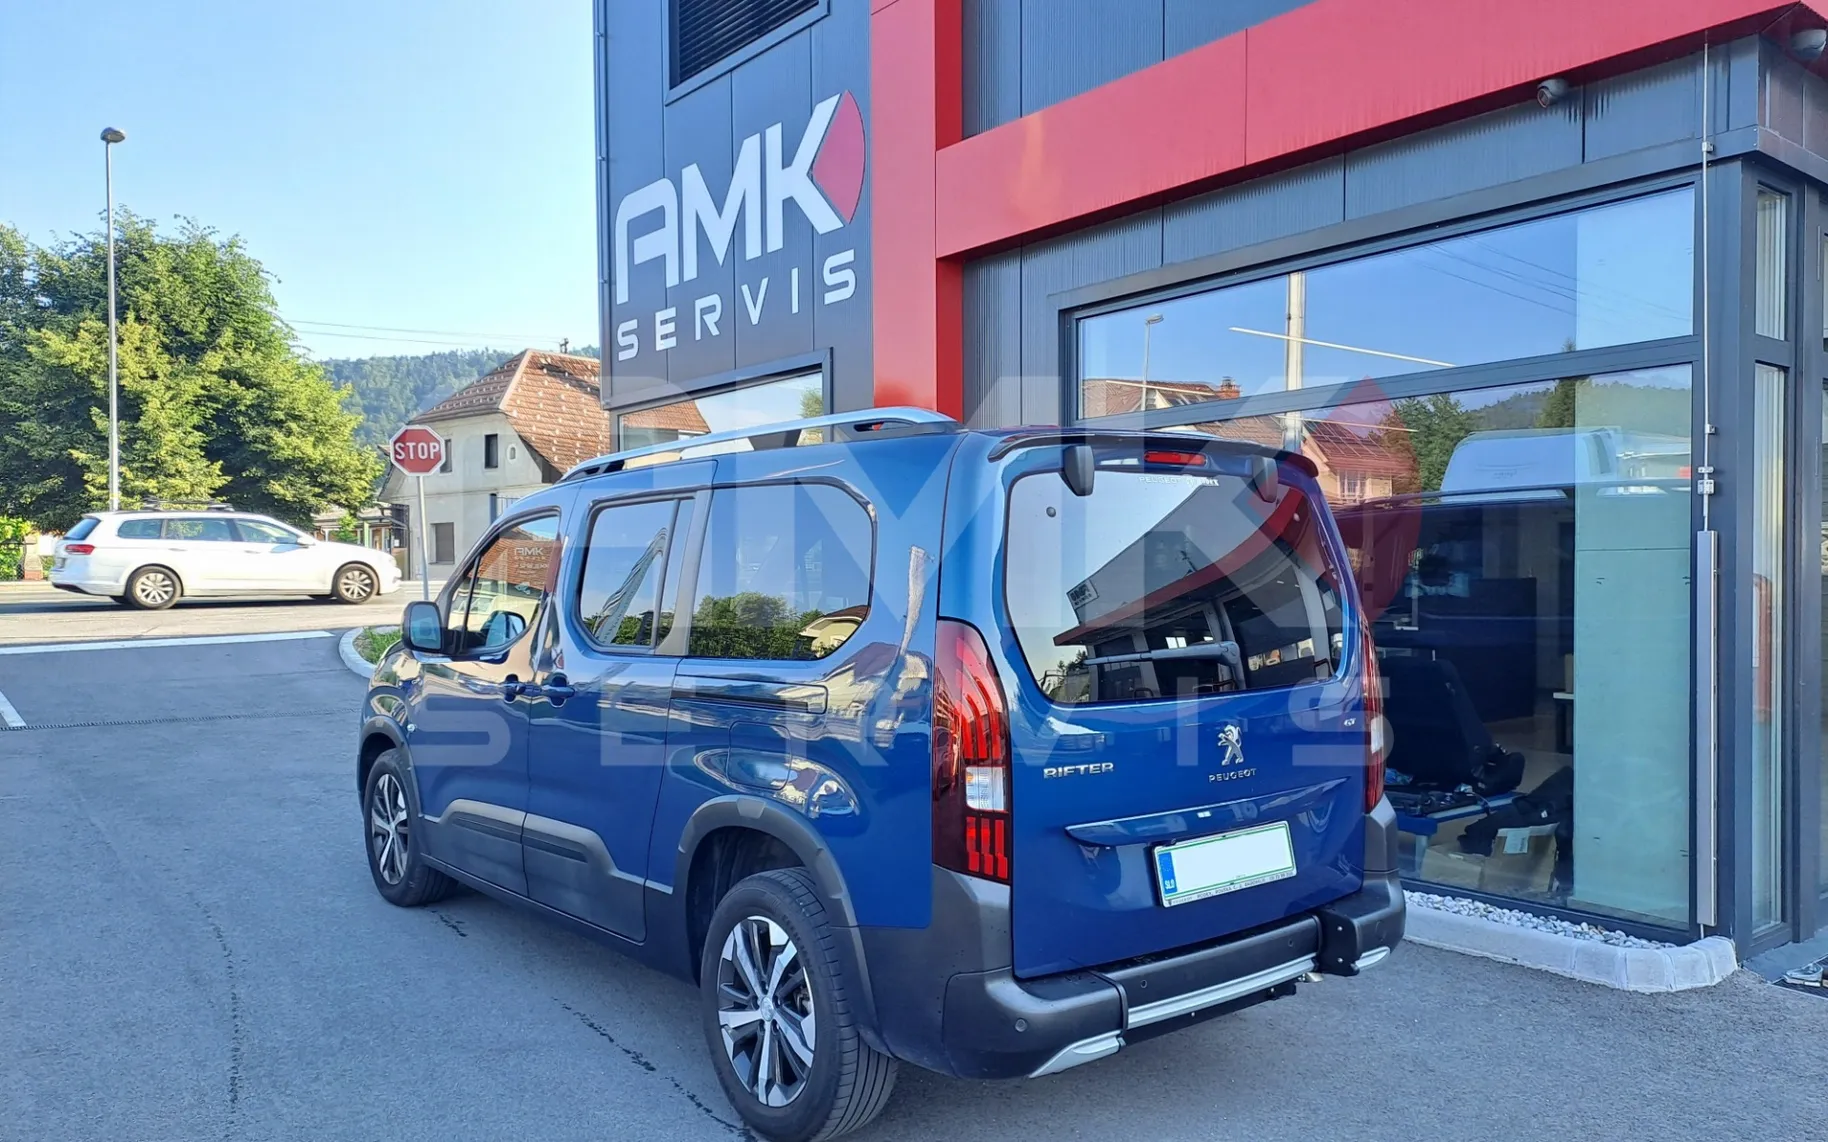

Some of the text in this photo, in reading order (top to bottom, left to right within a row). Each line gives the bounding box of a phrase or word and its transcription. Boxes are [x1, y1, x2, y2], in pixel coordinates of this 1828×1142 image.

[615, 93, 844, 304] AMK
[617, 249, 857, 361] SERVIS
[395, 442, 440, 460] STOP
[1043, 762, 1114, 779] RIFTER
[1208, 767, 1257, 783] PEUGEOT
